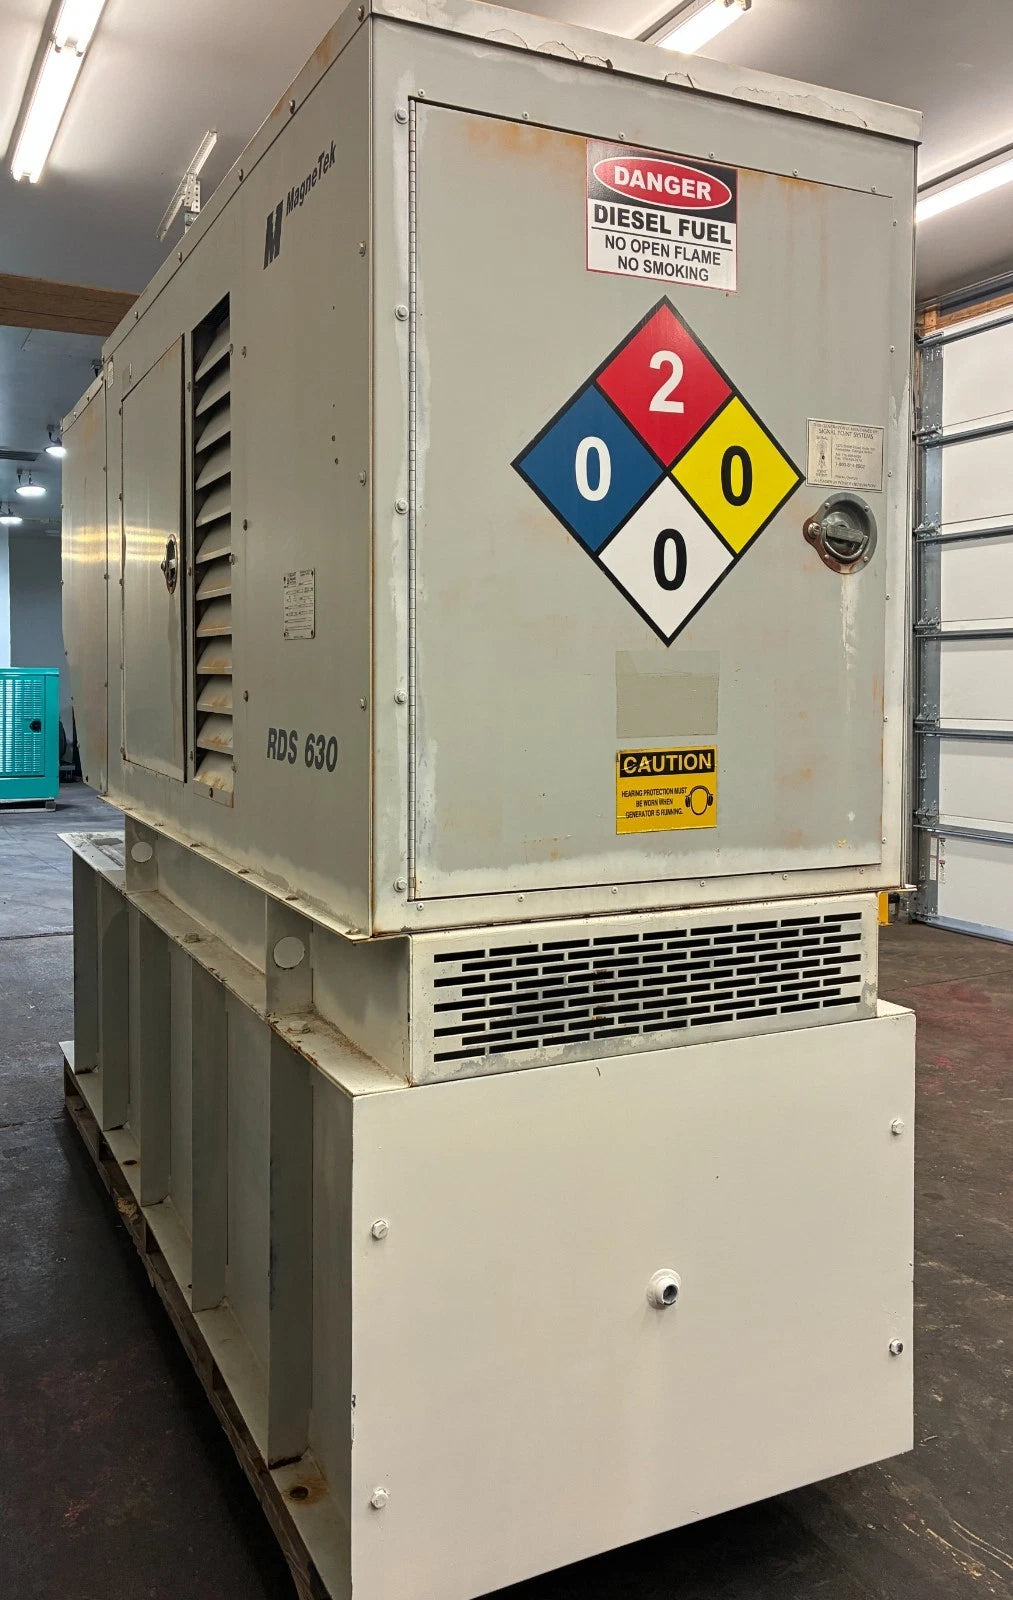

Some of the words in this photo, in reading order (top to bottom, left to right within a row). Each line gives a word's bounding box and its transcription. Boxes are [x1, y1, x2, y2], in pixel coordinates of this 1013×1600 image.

[286, 140, 337, 217] MagneTek
[614, 165, 712, 201] DANGER
[594, 203, 671, 234] DIESEL
[679, 218, 731, 244] FUEL
[605, 234, 626, 250] NO
[630, 239, 670, 258] OPEN
[674, 245, 721, 265] FLAME
[618, 256, 638, 271] NO
[643, 260, 709, 281] SMOKING
[649, 350, 684, 414] 2
[575, 436, 611, 501] 0
[720, 445, 753, 507] 0
[653, 528, 687, 591] 0
[267, 728, 298, 764] RDS
[305, 733, 338, 772] 630
[623, 753, 712, 774] CAUTION
[621, 789, 643, 798] HEARING
[643, 788, 673, 796] PROTECTION
[643, 799, 658, 807] WORN
[659, 798, 673, 806] WHEN
[625, 809, 655, 818] GENERATOR
